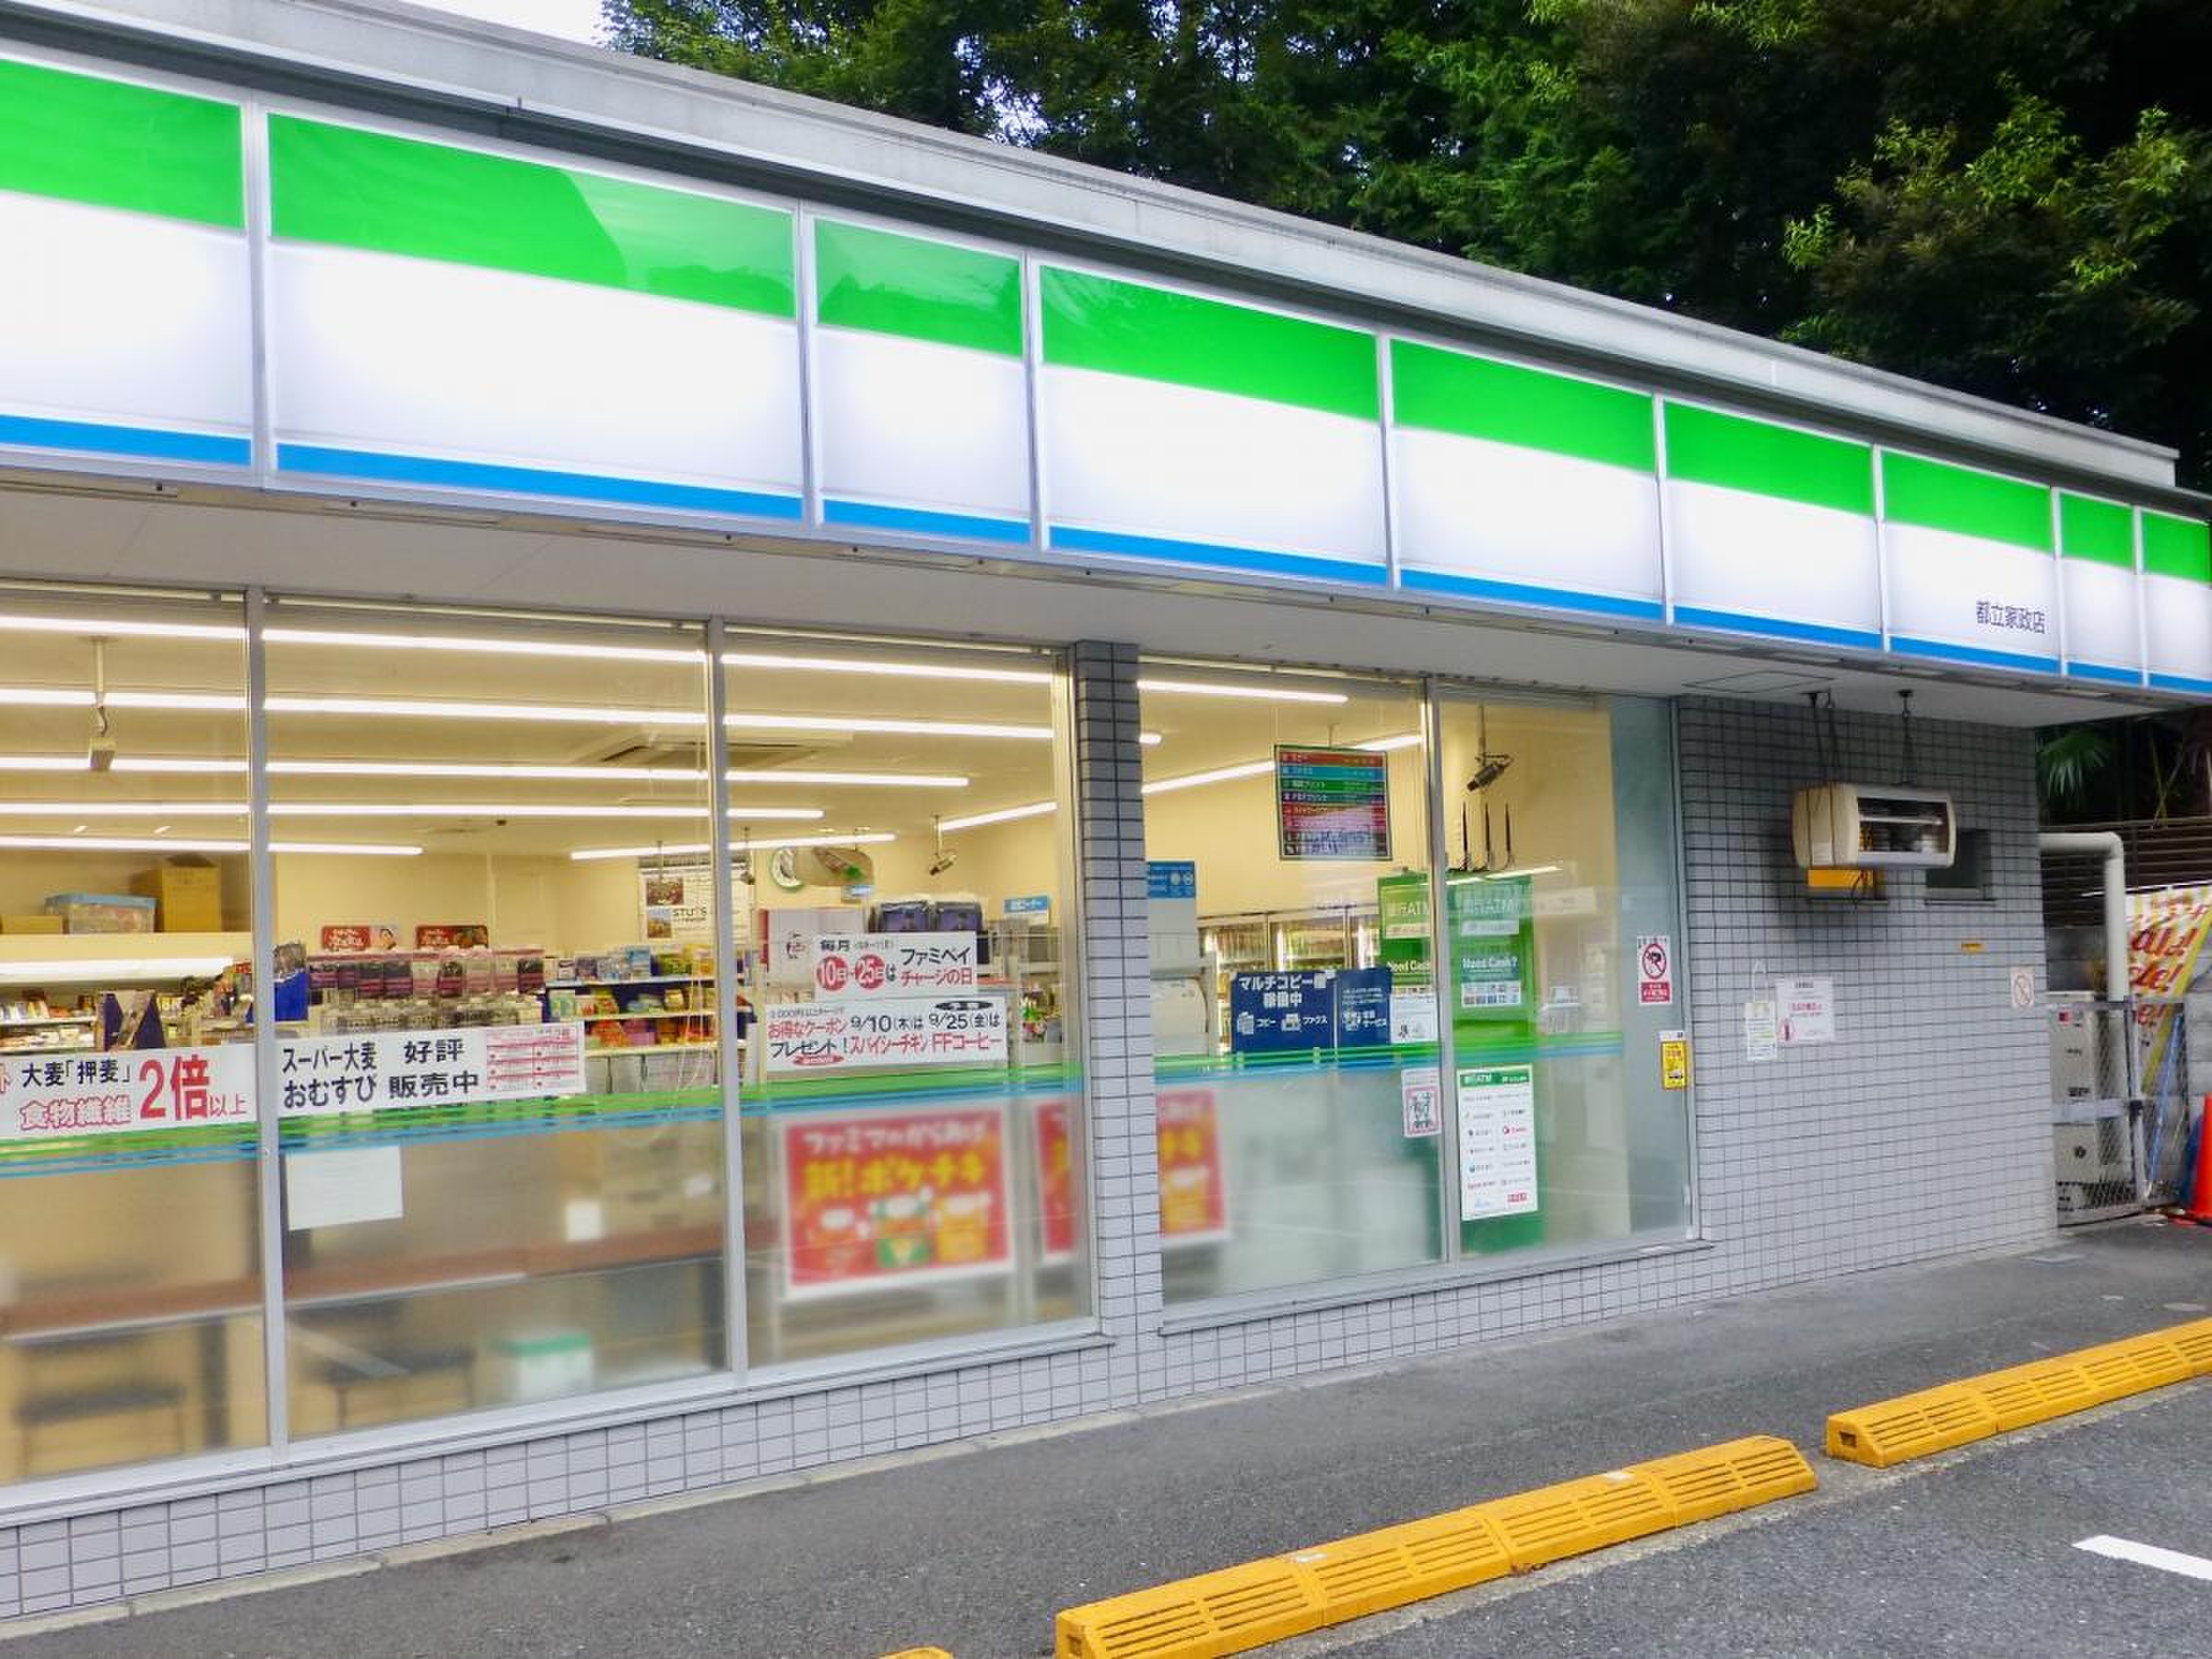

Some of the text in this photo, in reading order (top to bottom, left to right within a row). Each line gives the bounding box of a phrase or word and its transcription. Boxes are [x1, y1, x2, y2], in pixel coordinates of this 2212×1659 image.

[1976, 601, 2045, 634] 都立家政店
[900, 947, 971, 967] ファミペイ
[900, 967, 974, 988] チャージの日
[768, 1017, 847, 1040] お得なクーポン
[932, 1030, 1004, 1053] FFコーヒー
[282, 1041, 377, 1073] スーパー大麦
[403, 1038, 465, 1065] 好評
[283, 1070, 479, 1109] おむすび 販売中
[19, 1094, 133, 1131] 食物繊維
